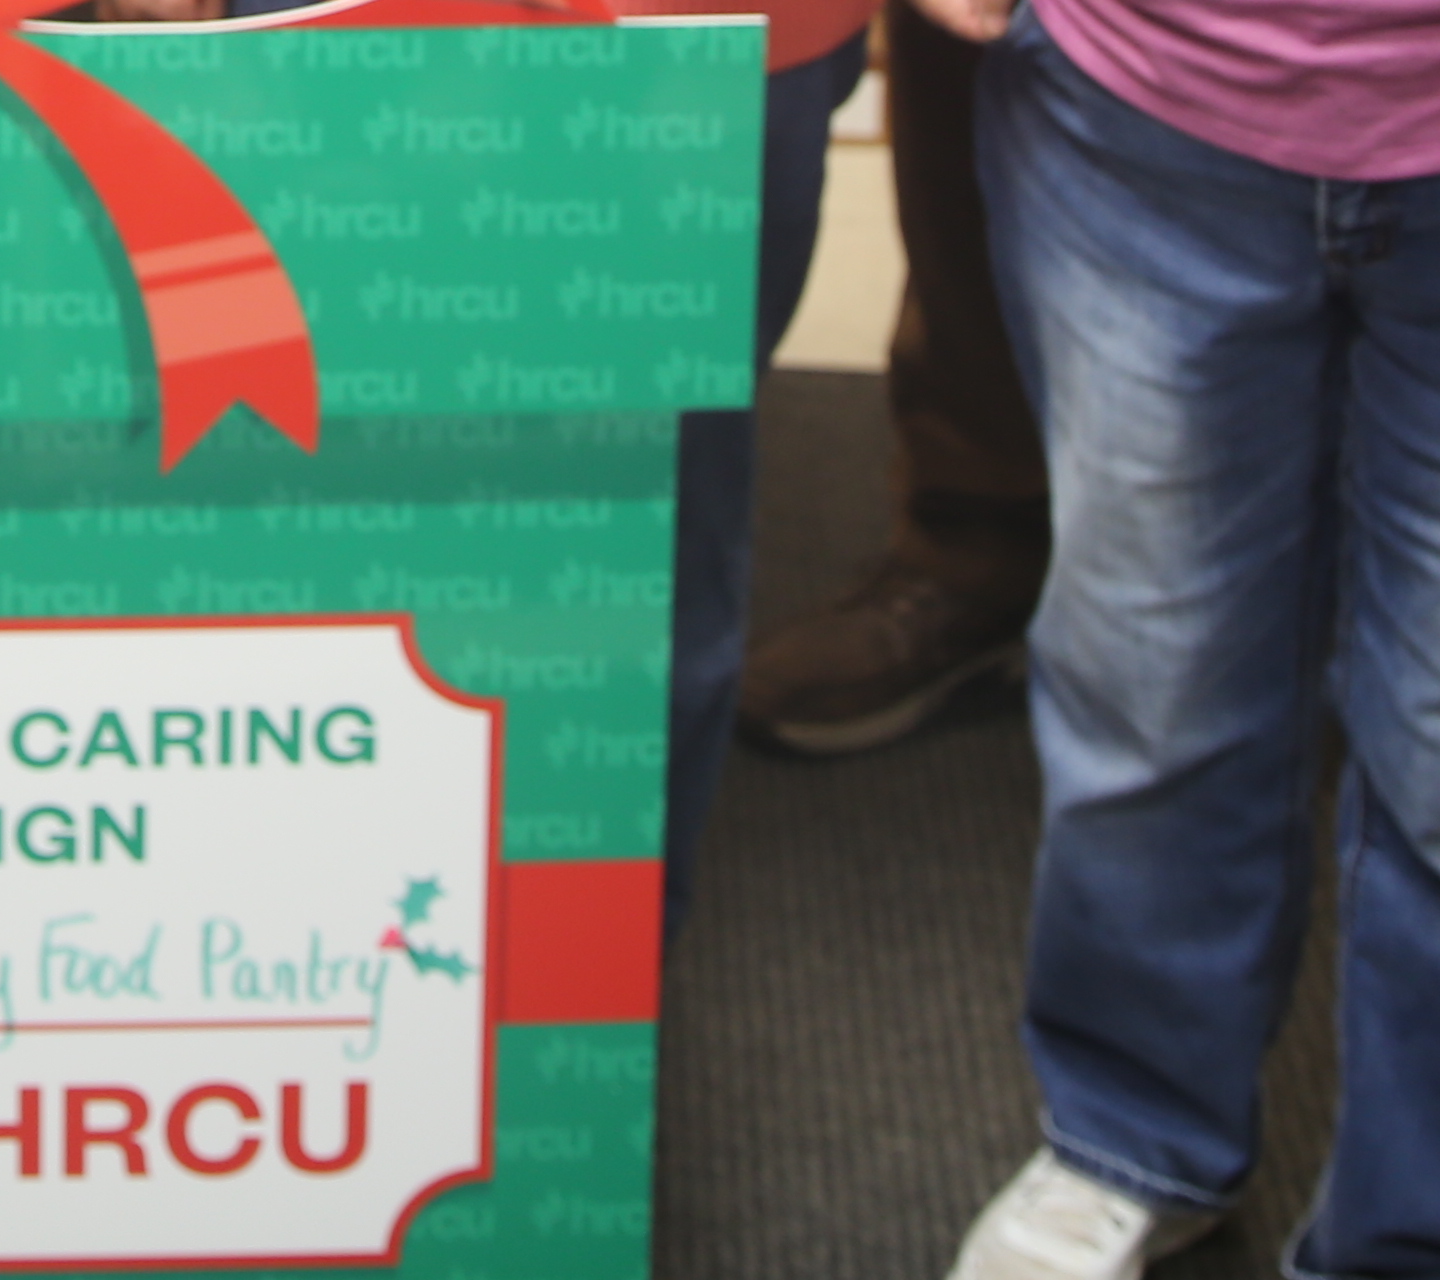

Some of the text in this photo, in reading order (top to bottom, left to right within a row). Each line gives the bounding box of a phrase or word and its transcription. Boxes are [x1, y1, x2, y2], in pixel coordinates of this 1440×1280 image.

[403, 106, 523, 153] hrcu
[603, 104, 725, 153] hrcu
[303, 192, 424, 239] hrcu
[502, 191, 623, 237] hrcu
[401, 273, 521, 321] hrcu
[598, 271, 718, 321] hrcu
[497, 360, 616, 405] hrcu
[392, 563, 510, 610] hrcu
[7, 702, 382, 770] CARING
[38, 913, 162, 1004] Food
[197, 915, 393, 1063] Pantry
